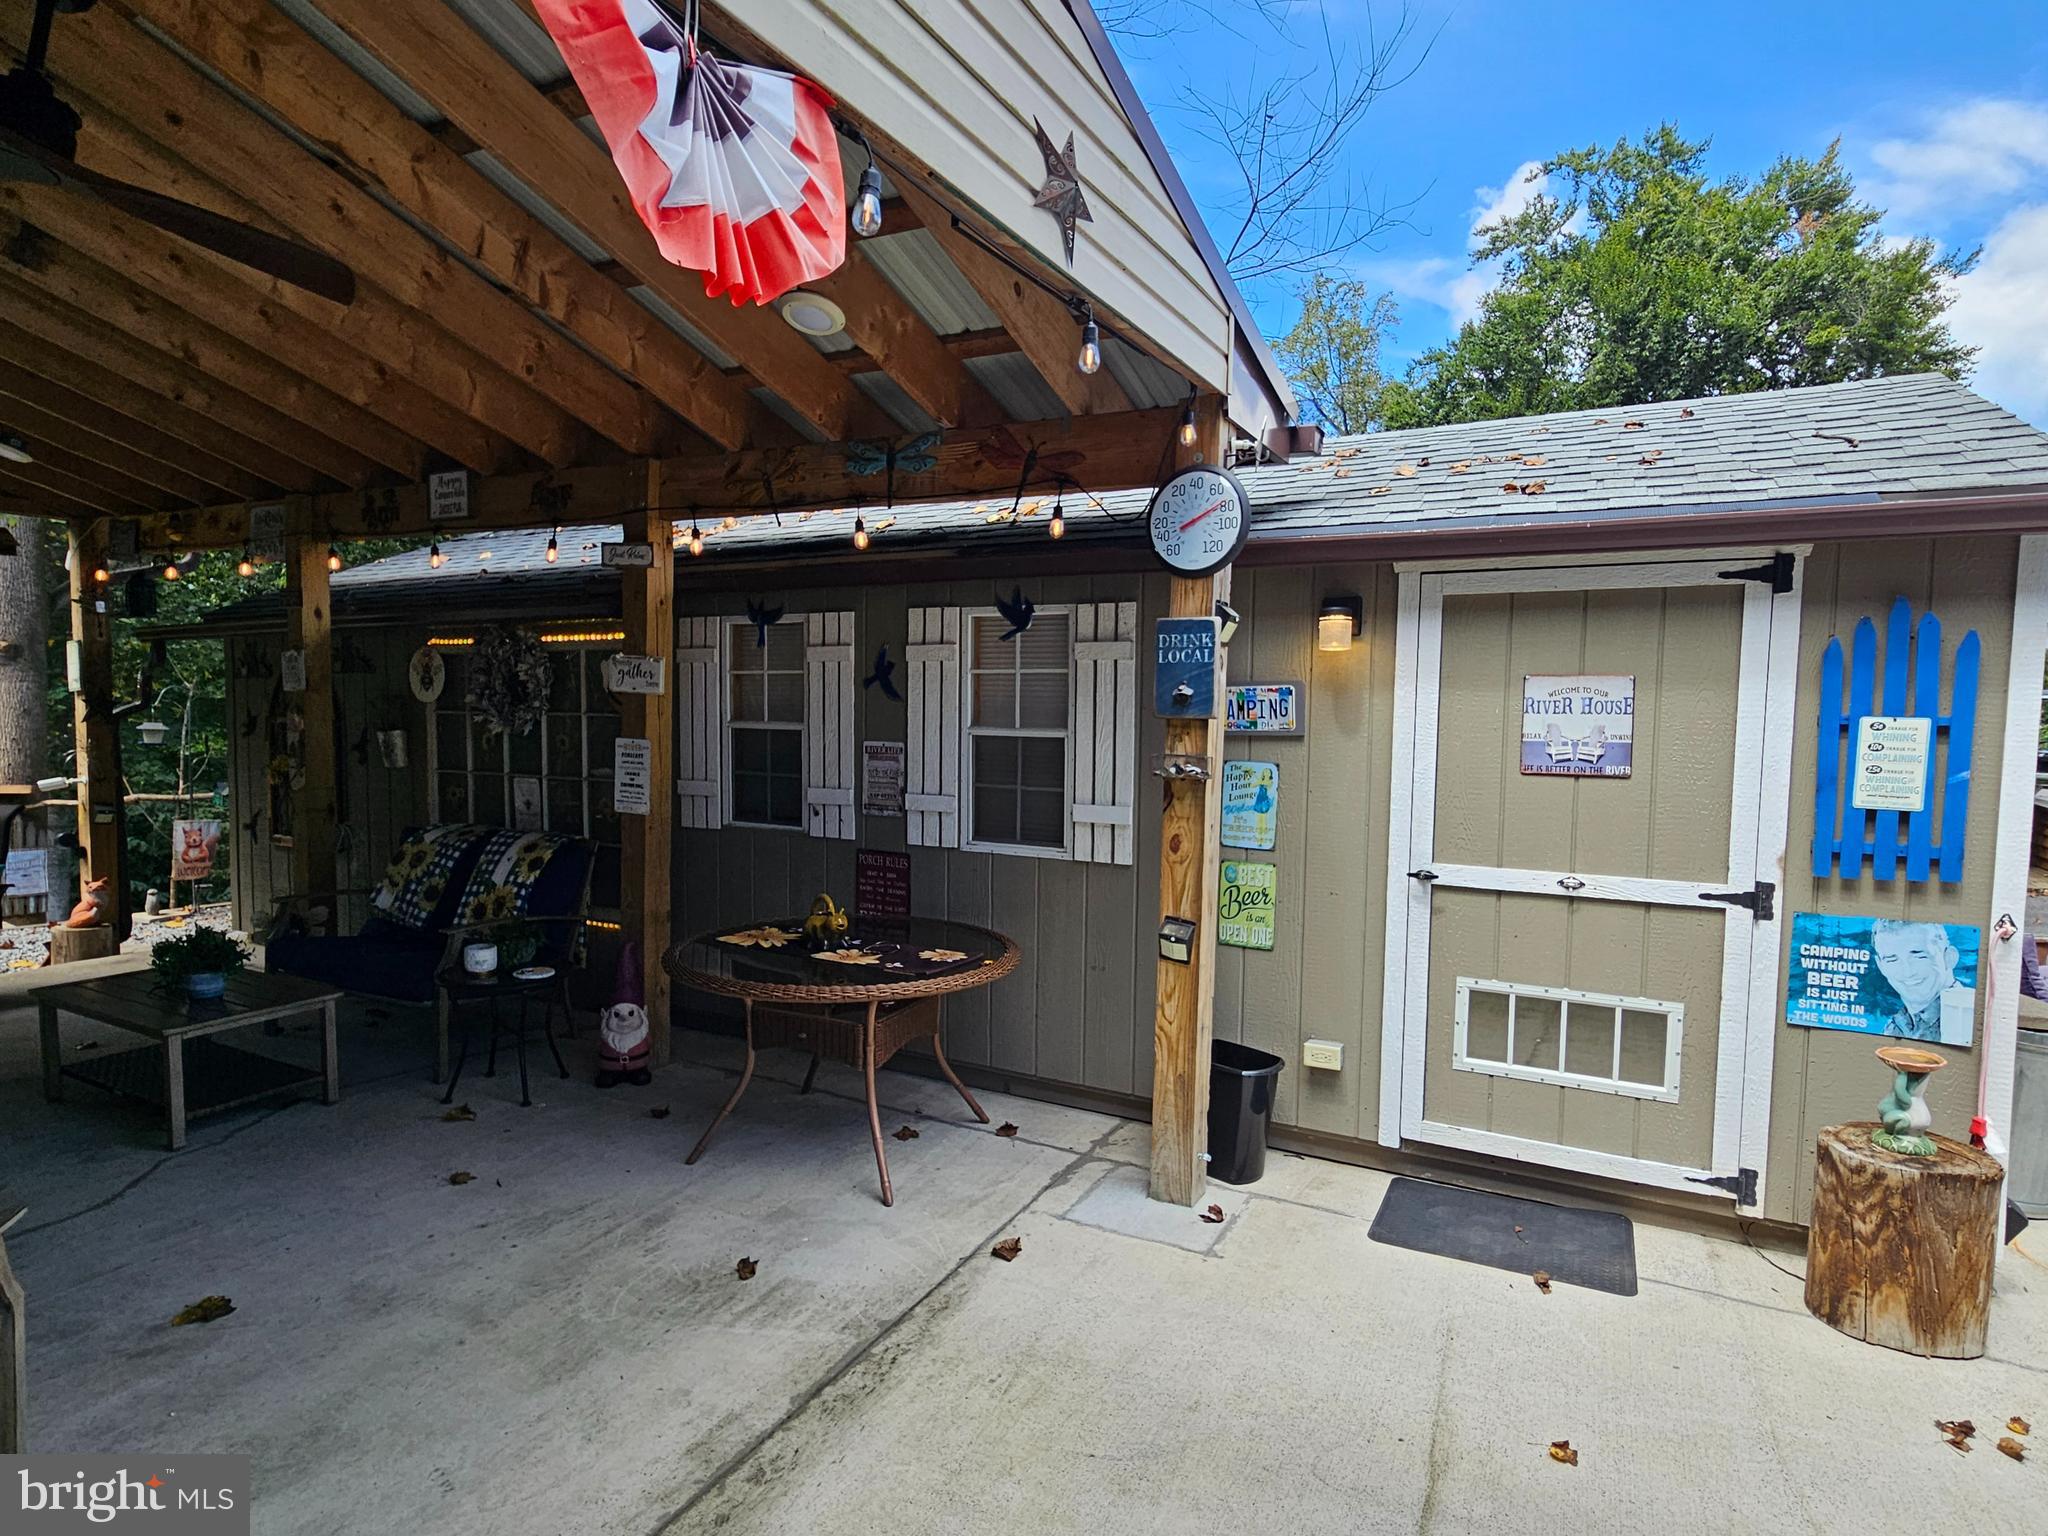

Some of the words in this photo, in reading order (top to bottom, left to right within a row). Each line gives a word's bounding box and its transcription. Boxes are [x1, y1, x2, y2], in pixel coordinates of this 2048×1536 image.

[1190, 477, 1204, 489] 40
[1210, 483, 1224, 495] 60
[1171, 484, 1186, 497] 20
[1163, 501, 1170, 513] 0
[1220, 500, 1234, 512] 80
[1219, 517, 1238, 530] 100
[1163, 544, 1180, 556] -60
[1203, 540, 1223, 553] 120
[1158, 632, 1213, 648] DRINK
[1158, 649, 1214, 664] LOCAL
[616, 663, 655, 688] gather
[1548, 687, 1580, 698] WELCOME
[1594, 689, 1609, 698] OUR
[1227, 698, 1289, 720] AMPING
[1524, 697, 1572, 715] RIVER
[1580, 697, 1633, 715] HOUSE
[1872, 732, 1917, 743] WHINING
[1862, 752, 1922, 764] COMPLAINING
[1230, 763, 1242, 772] The
[1546, 765, 1570, 773] BETTER
[1574, 766, 1587, 774] ON
[1589, 766, 1603, 774] THE
[1605, 766, 1631, 776] RIVER
[1226, 771, 1252, 782] Happy
[1865, 775, 1907, 785] WHINING
[1231, 782, 1251, 791] Hour
[1859, 783, 1920, 795] COMPLAINING
[859, 852, 883, 866] PORCH
[885, 856, 908, 869] RULES
[1239, 864, 1273, 888] BEST
[1220, 885, 1272, 920] Beer
[1246, 912, 1253, 922] is
[1255, 915, 1265, 923] an
[1220, 924, 1249, 943] OPEN
[1252, 926, 1273, 947] ONE
[1800, 944, 1870, 961] CAMPING
[1801, 957, 1868, 974] WITHOUT
[1807, 971, 1859, 990] BEER
[1806, 987, 1820, 998] IS
[1822, 989, 1858, 1002] JUST
[1798, 998, 1848, 1014] SITTING
[1850, 1004, 1865, 1015] IN
[1794, 1010, 1818, 1023] THE
[1823, 1013, 1868, 1029] WOODS
